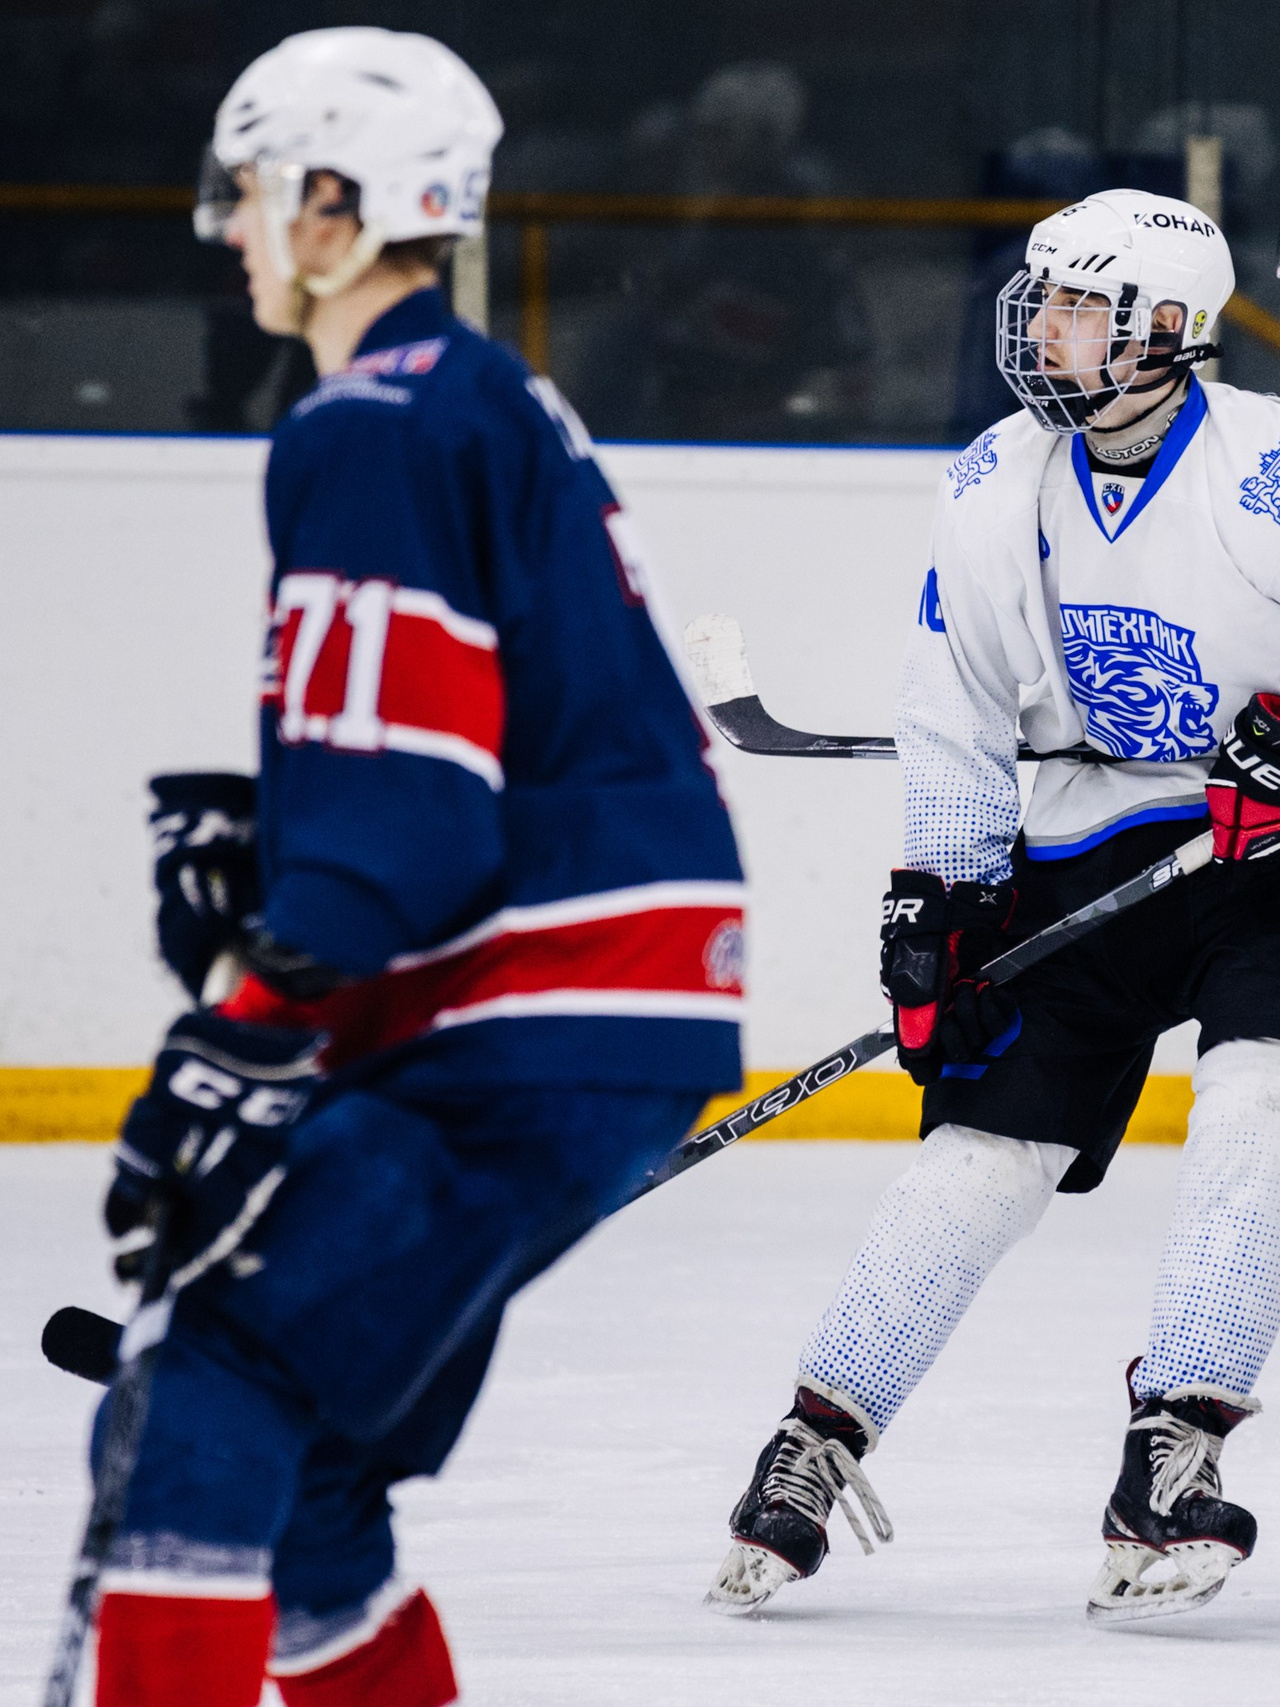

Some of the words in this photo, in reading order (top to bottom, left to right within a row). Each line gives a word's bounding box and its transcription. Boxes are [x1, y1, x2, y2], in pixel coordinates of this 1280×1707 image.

[1032, 243, 1058, 255] CCM
[1090, 433, 1160, 460] ASTON
[1059, 609, 1194, 666] ЛИТЕХНИК
[276, 573, 390, 751] 71
